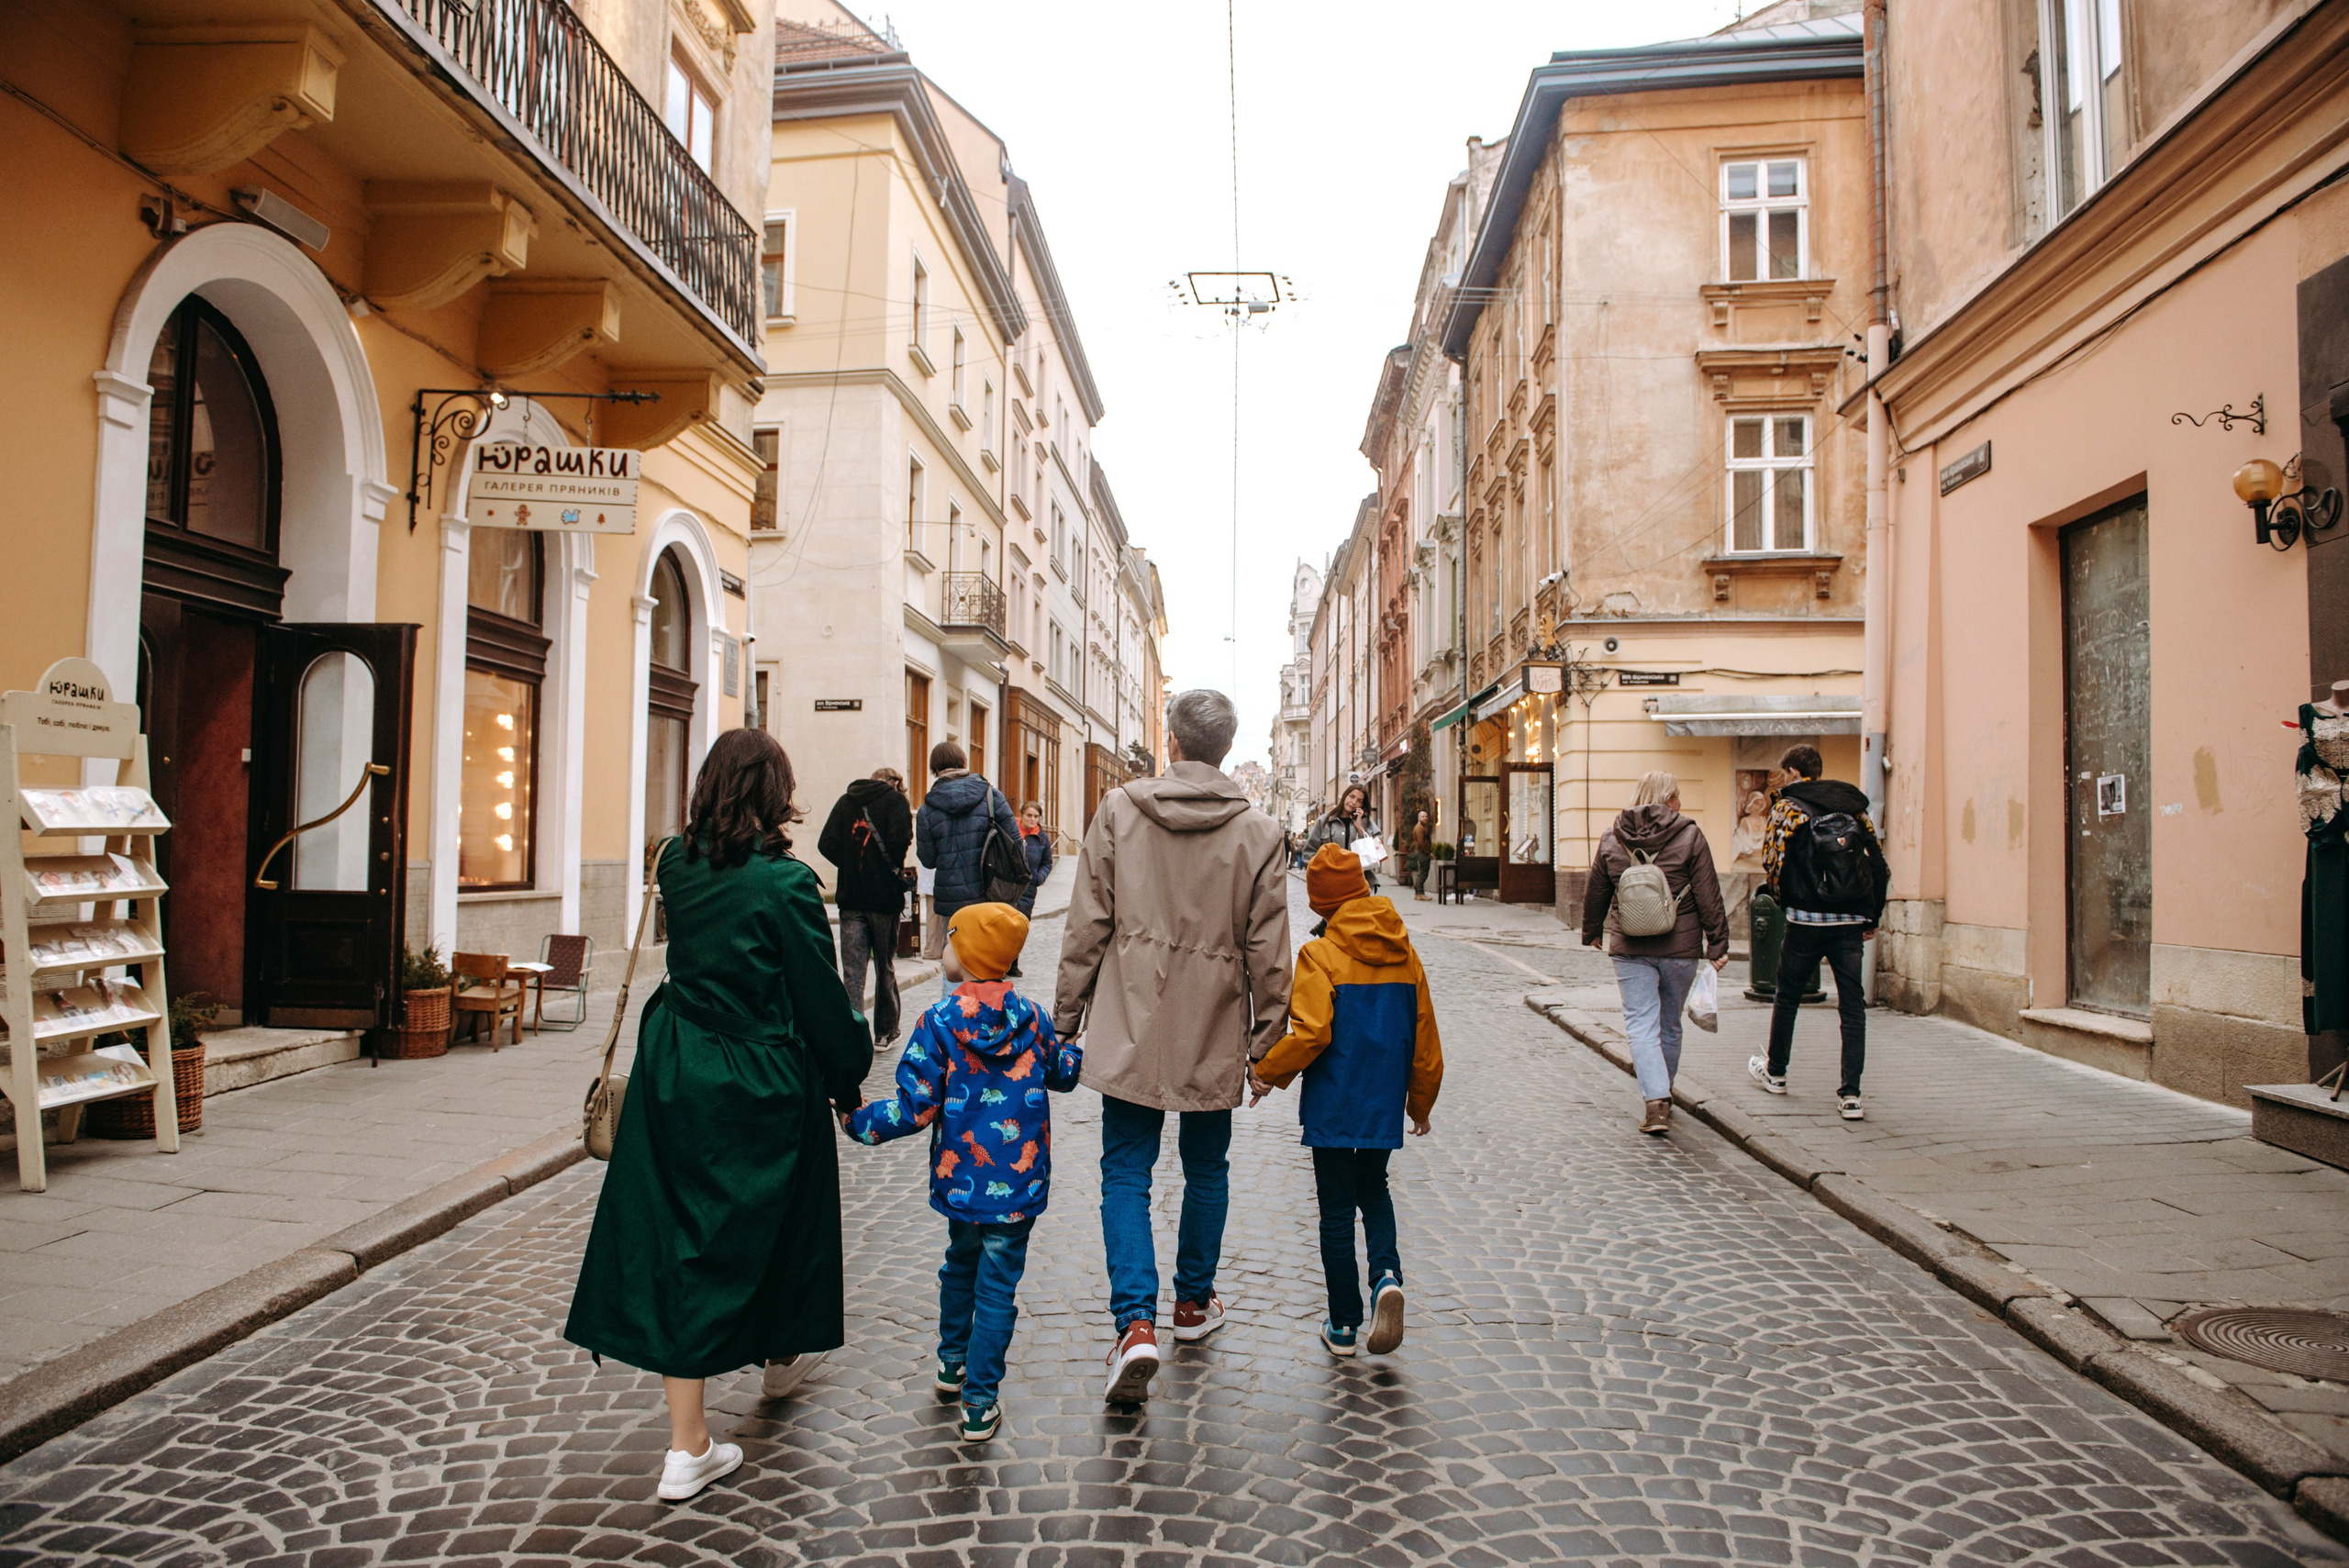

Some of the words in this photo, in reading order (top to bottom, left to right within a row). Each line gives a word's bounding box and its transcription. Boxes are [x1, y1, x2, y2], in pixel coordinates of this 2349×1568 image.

[478, 446, 628, 478] Юрашки
[484, 481, 544, 493] ГАЛЕРЕЯ
[550, 484, 621, 496] ПРЯНИКІВ
